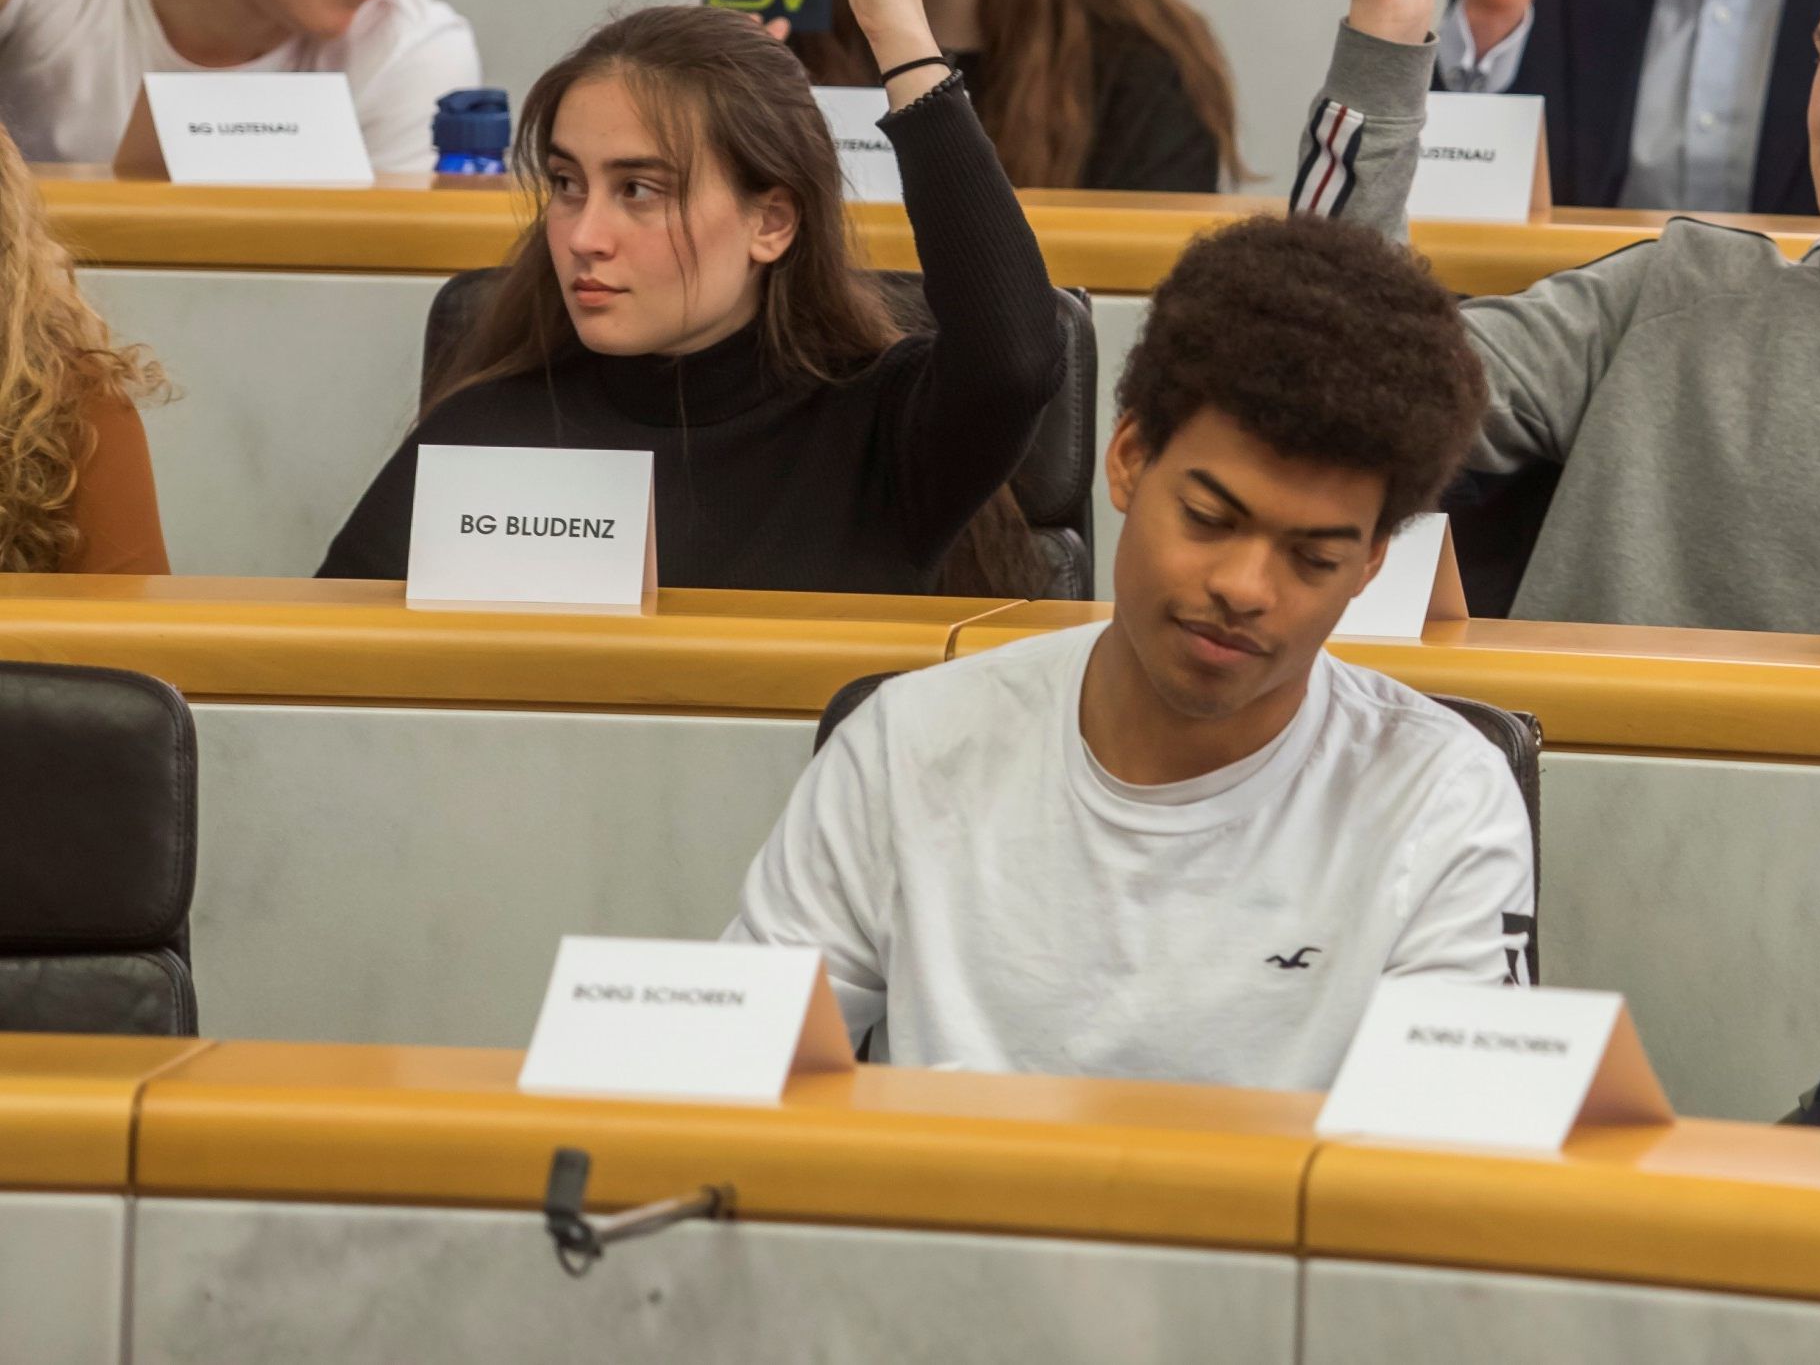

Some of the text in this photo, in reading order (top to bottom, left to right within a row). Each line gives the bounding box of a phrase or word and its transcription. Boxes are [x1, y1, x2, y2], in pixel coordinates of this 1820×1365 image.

[188, 122, 298, 135] BG LUSTENAU
[460, 514, 615, 539] BG BLUDENZ
